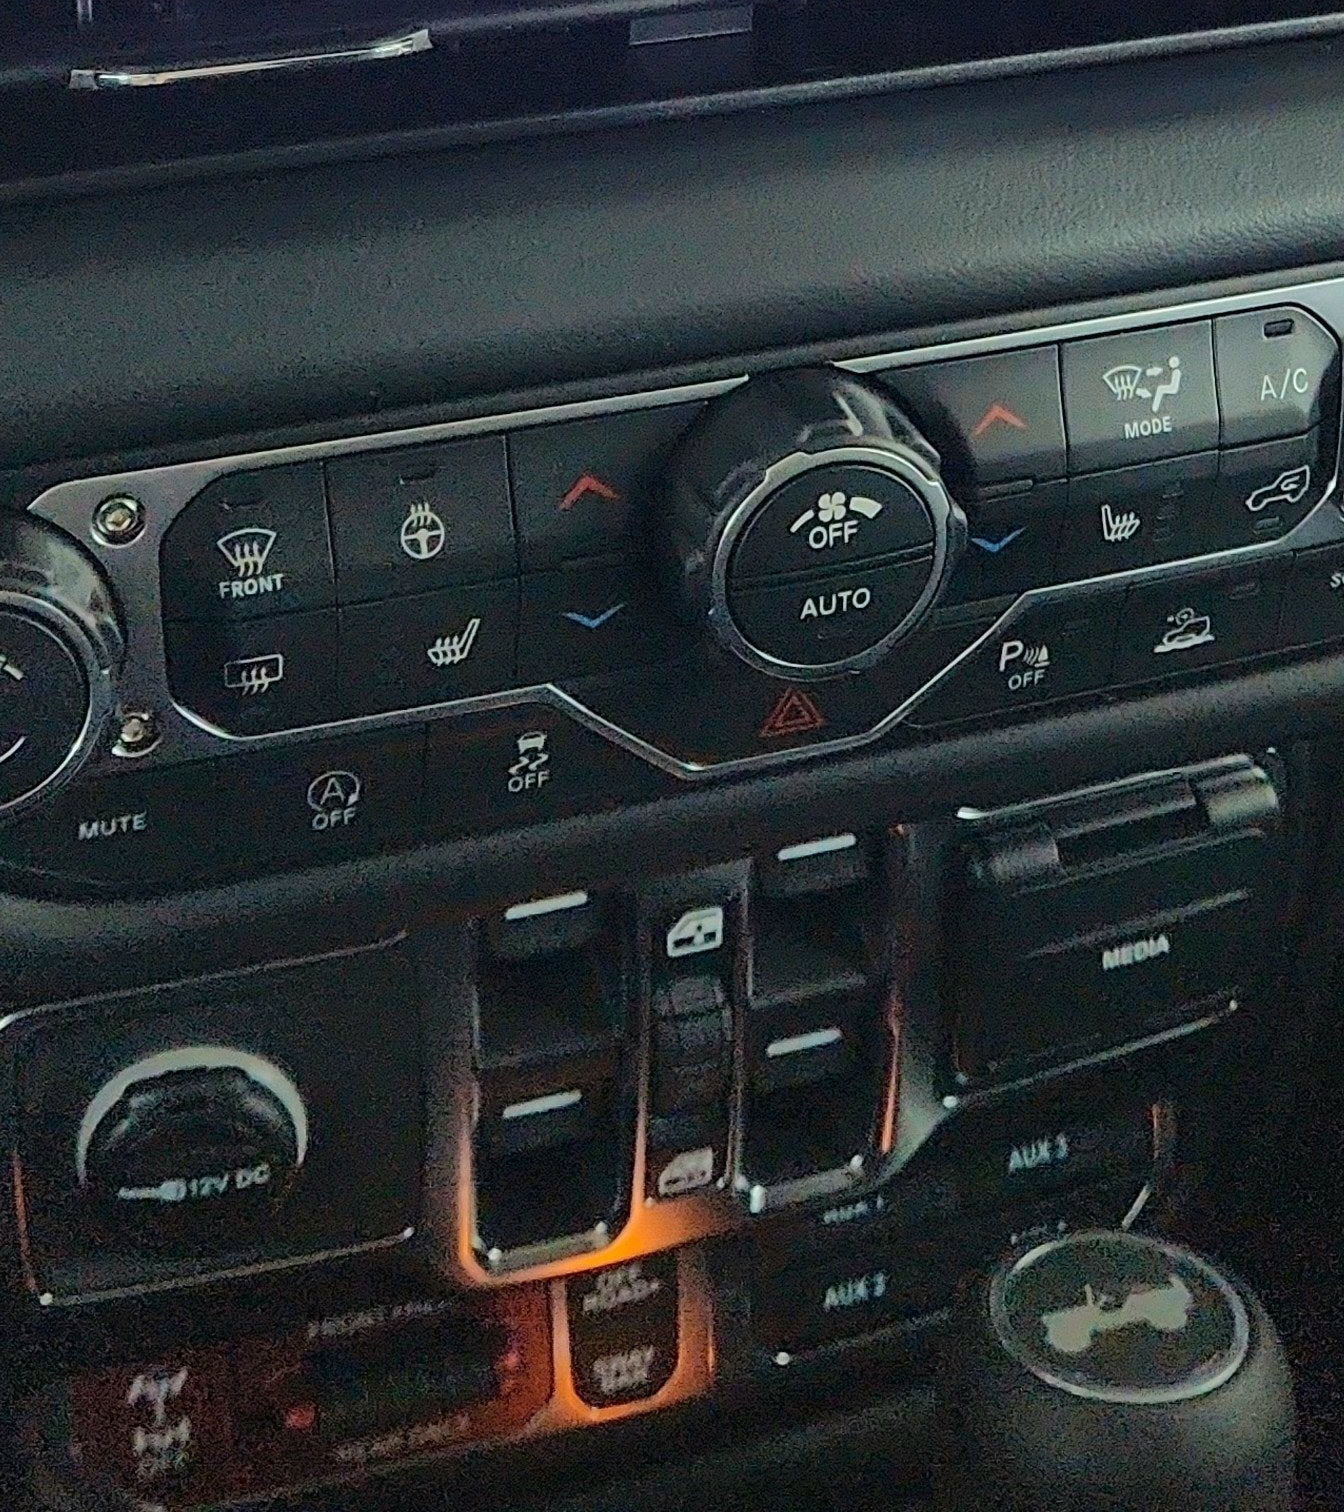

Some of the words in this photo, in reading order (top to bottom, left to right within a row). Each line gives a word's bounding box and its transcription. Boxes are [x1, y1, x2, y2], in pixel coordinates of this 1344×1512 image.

[1260, 366, 1309, 402] A/C
[1124, 415, 1173, 441] MODE
[807, 519, 859, 550] OFF
[218, 573, 284, 599] FRONT
[799, 587, 872, 620] AUTO
[1007, 668, 1046, 691] OFF
[507, 770, 552, 794] OFF
[77, 809, 147, 842] MUTE
[311, 809, 358, 832] OFF
[1102, 933, 1171, 970] MEDIA
[1008, 1138, 1052, 1173] AUX
[823, 1276, 870, 1311] AUX
